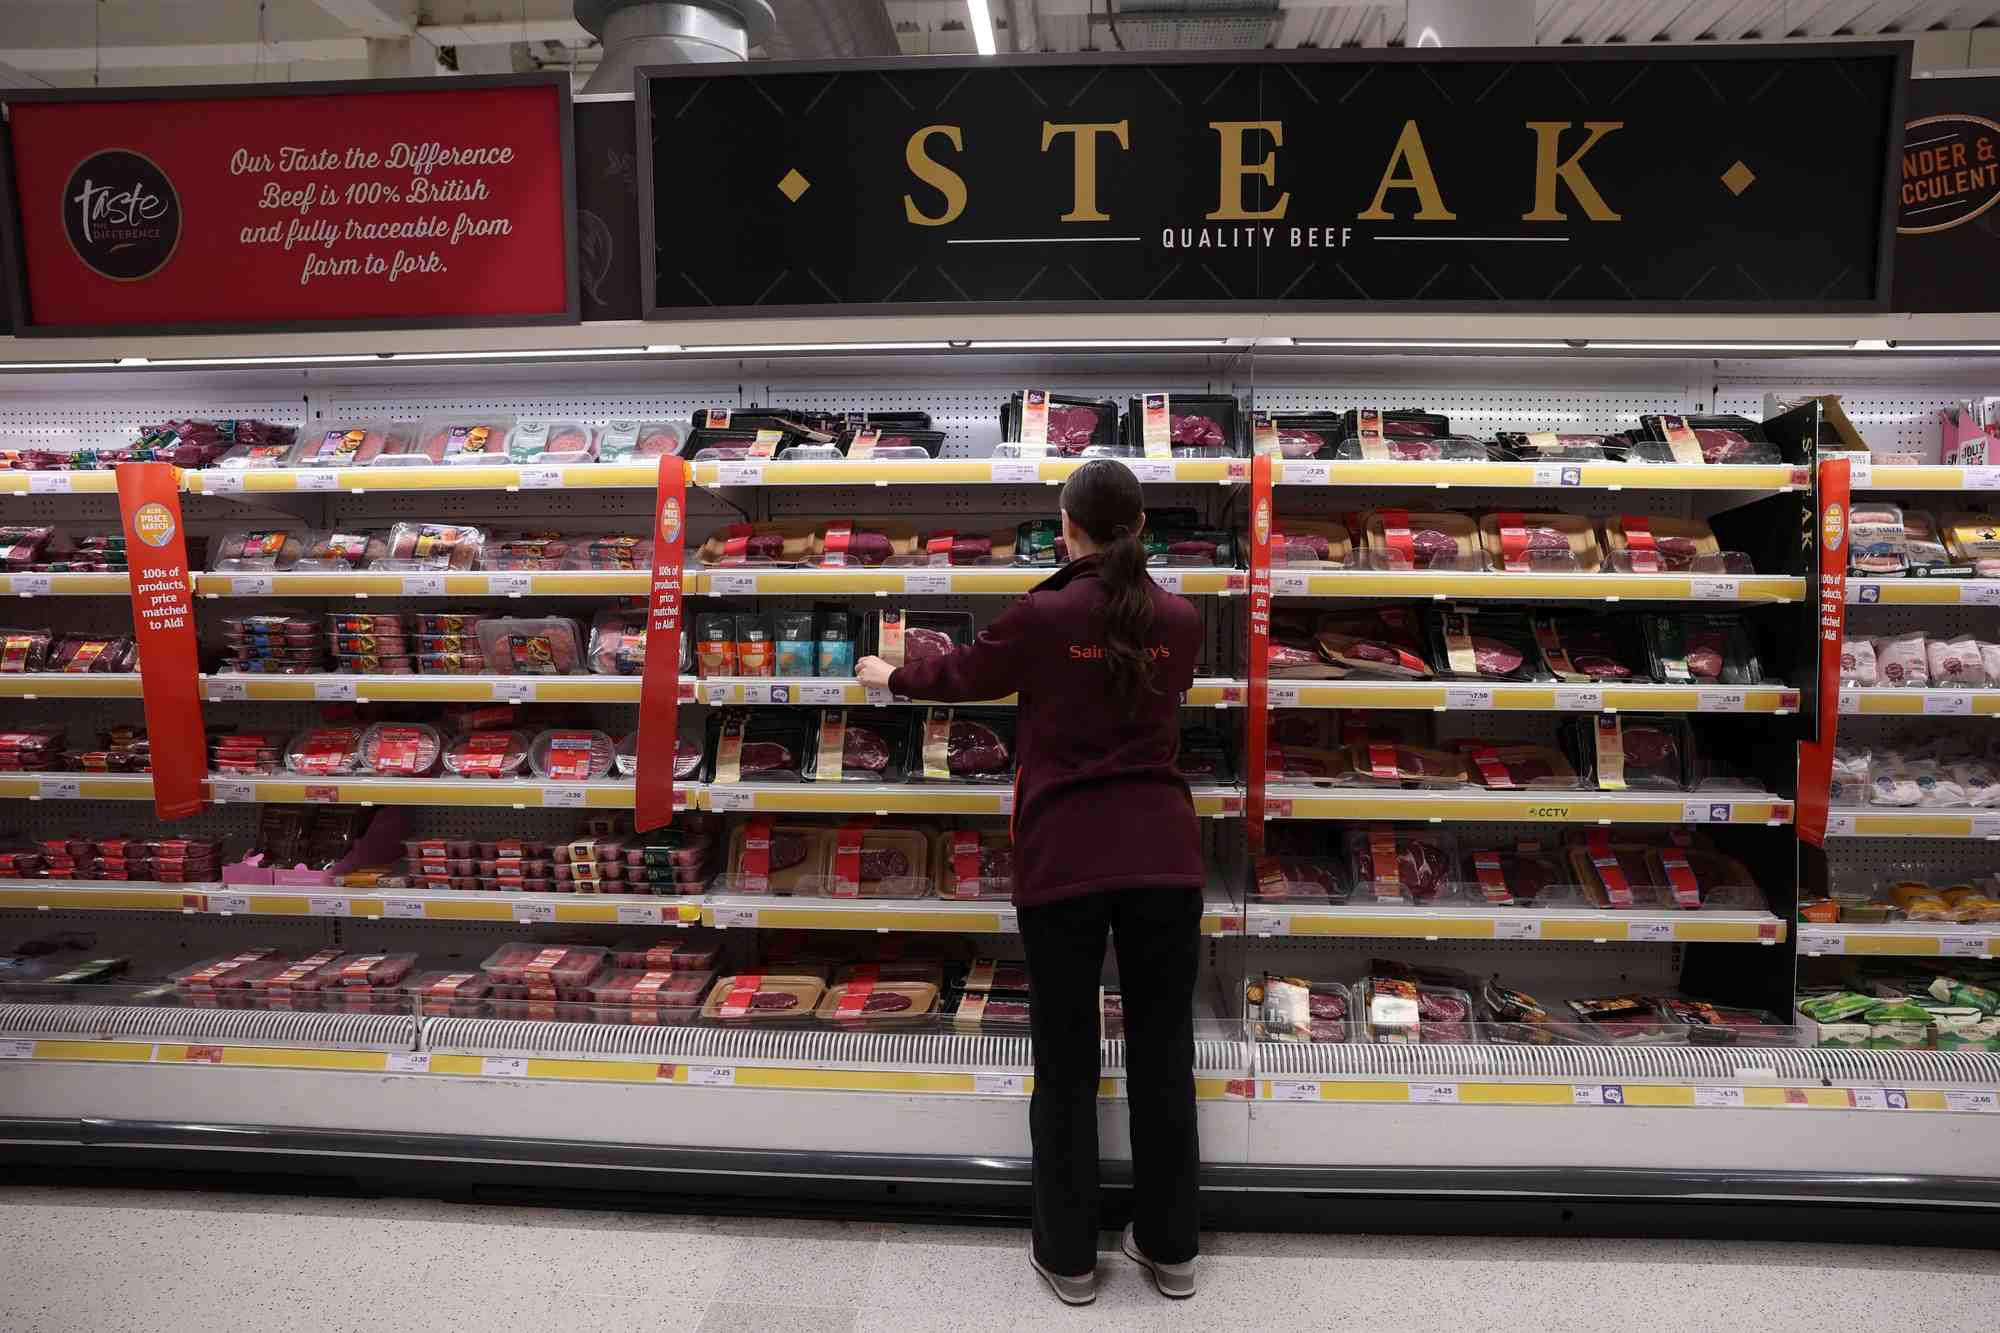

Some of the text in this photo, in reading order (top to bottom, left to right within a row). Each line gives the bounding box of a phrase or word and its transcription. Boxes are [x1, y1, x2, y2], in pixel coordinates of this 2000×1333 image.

[1976, 137, 1996, 161] &
[231, 142, 515, 175] Our Taste the Difference
[904, 119, 1624, 227] STEAK
[1898, 163, 1999, 206] CCULENT
[258, 177, 490, 215] Beef is 100% British
[74, 179, 169, 244] taste
[240, 212, 513, 250] and fully traceable from
[1163, 226, 1352, 249] QUALITY BEEF
[300, 250, 448, 285] farm to fork.
[140, 514, 168, 523] PRICE
[142, 566, 180, 579] 100s of
[671, 565, 679, 576] of
[137, 579, 187, 594] products,
[1820, 574, 1834, 585] 00s
[150, 592, 177, 606] price
[659, 592, 674, 605] price
[1820, 588, 1842, 600] oducts,
[142, 604, 188, 618] matched
[653, 604, 678, 617] matched
[149, 616, 184, 631] to Aldi
[655, 617, 675, 630] to Aldi
[1538, 807, 1569, 818] CCTV
